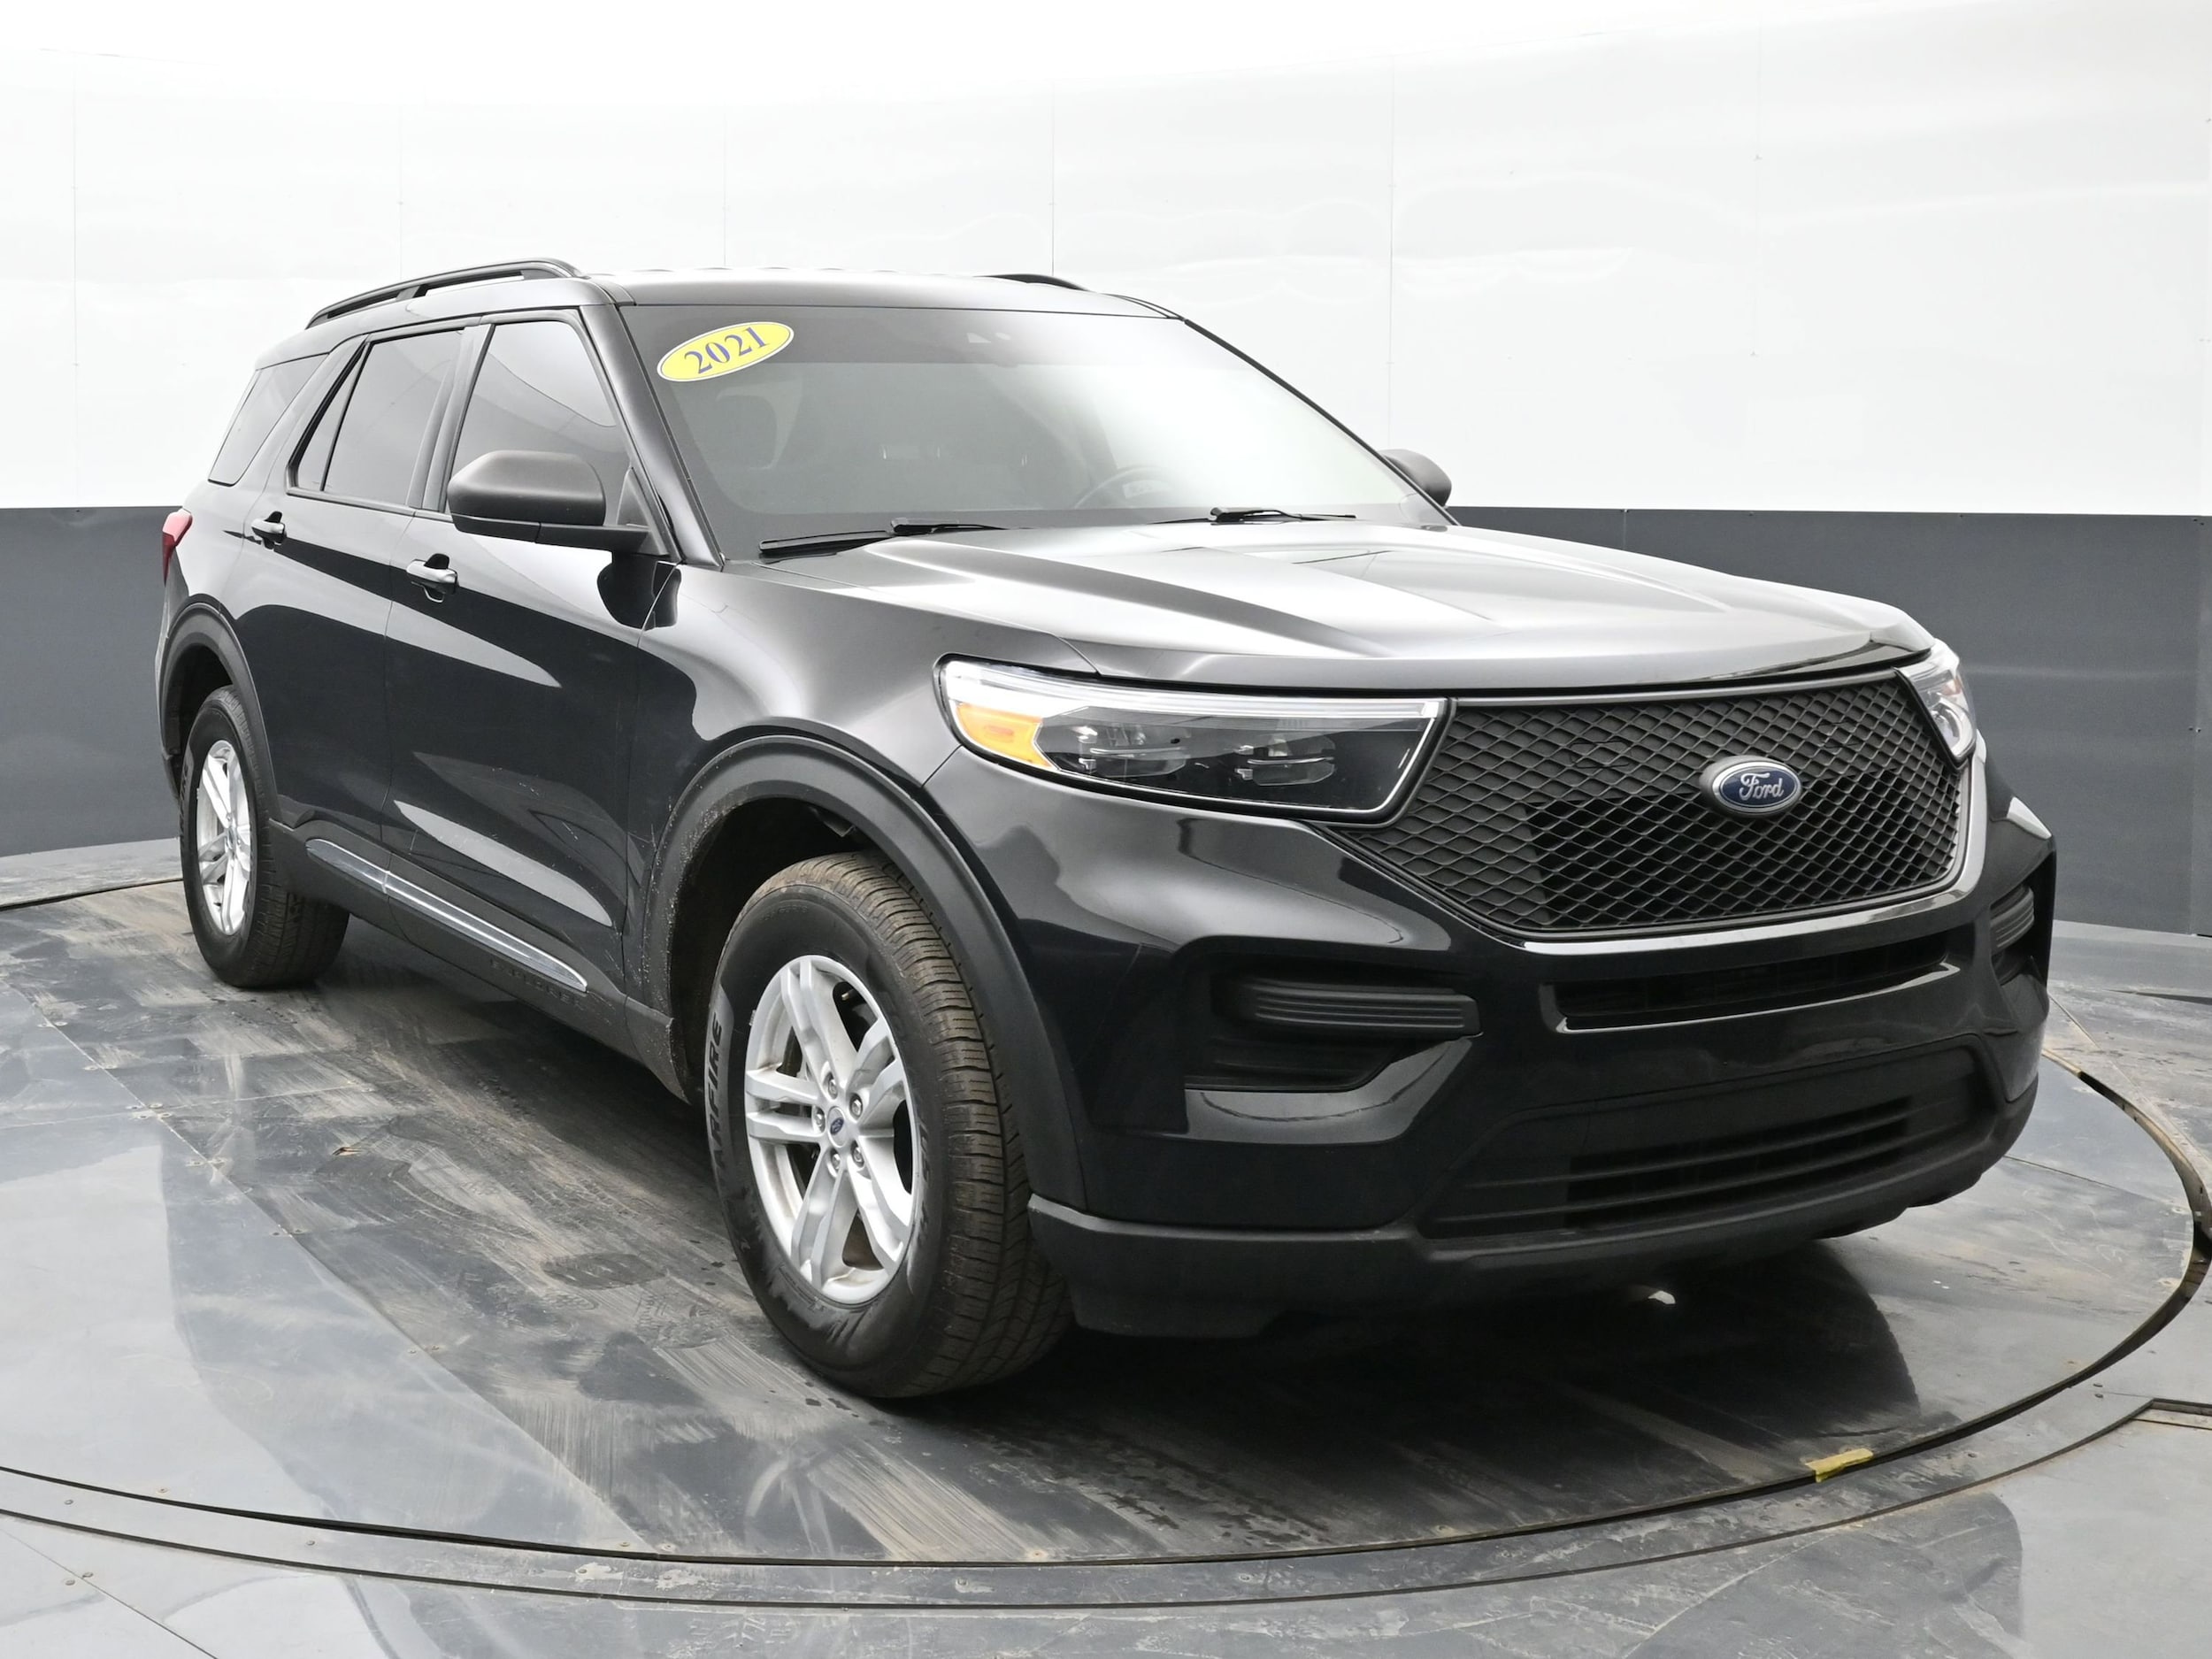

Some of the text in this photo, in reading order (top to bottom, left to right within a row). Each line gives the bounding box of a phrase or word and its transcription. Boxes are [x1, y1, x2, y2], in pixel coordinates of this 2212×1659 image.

[684, 326, 769, 373] 2021
[1739, 772, 1784, 801] Ford
[708, 1011, 725, 1181] ARFIRE
